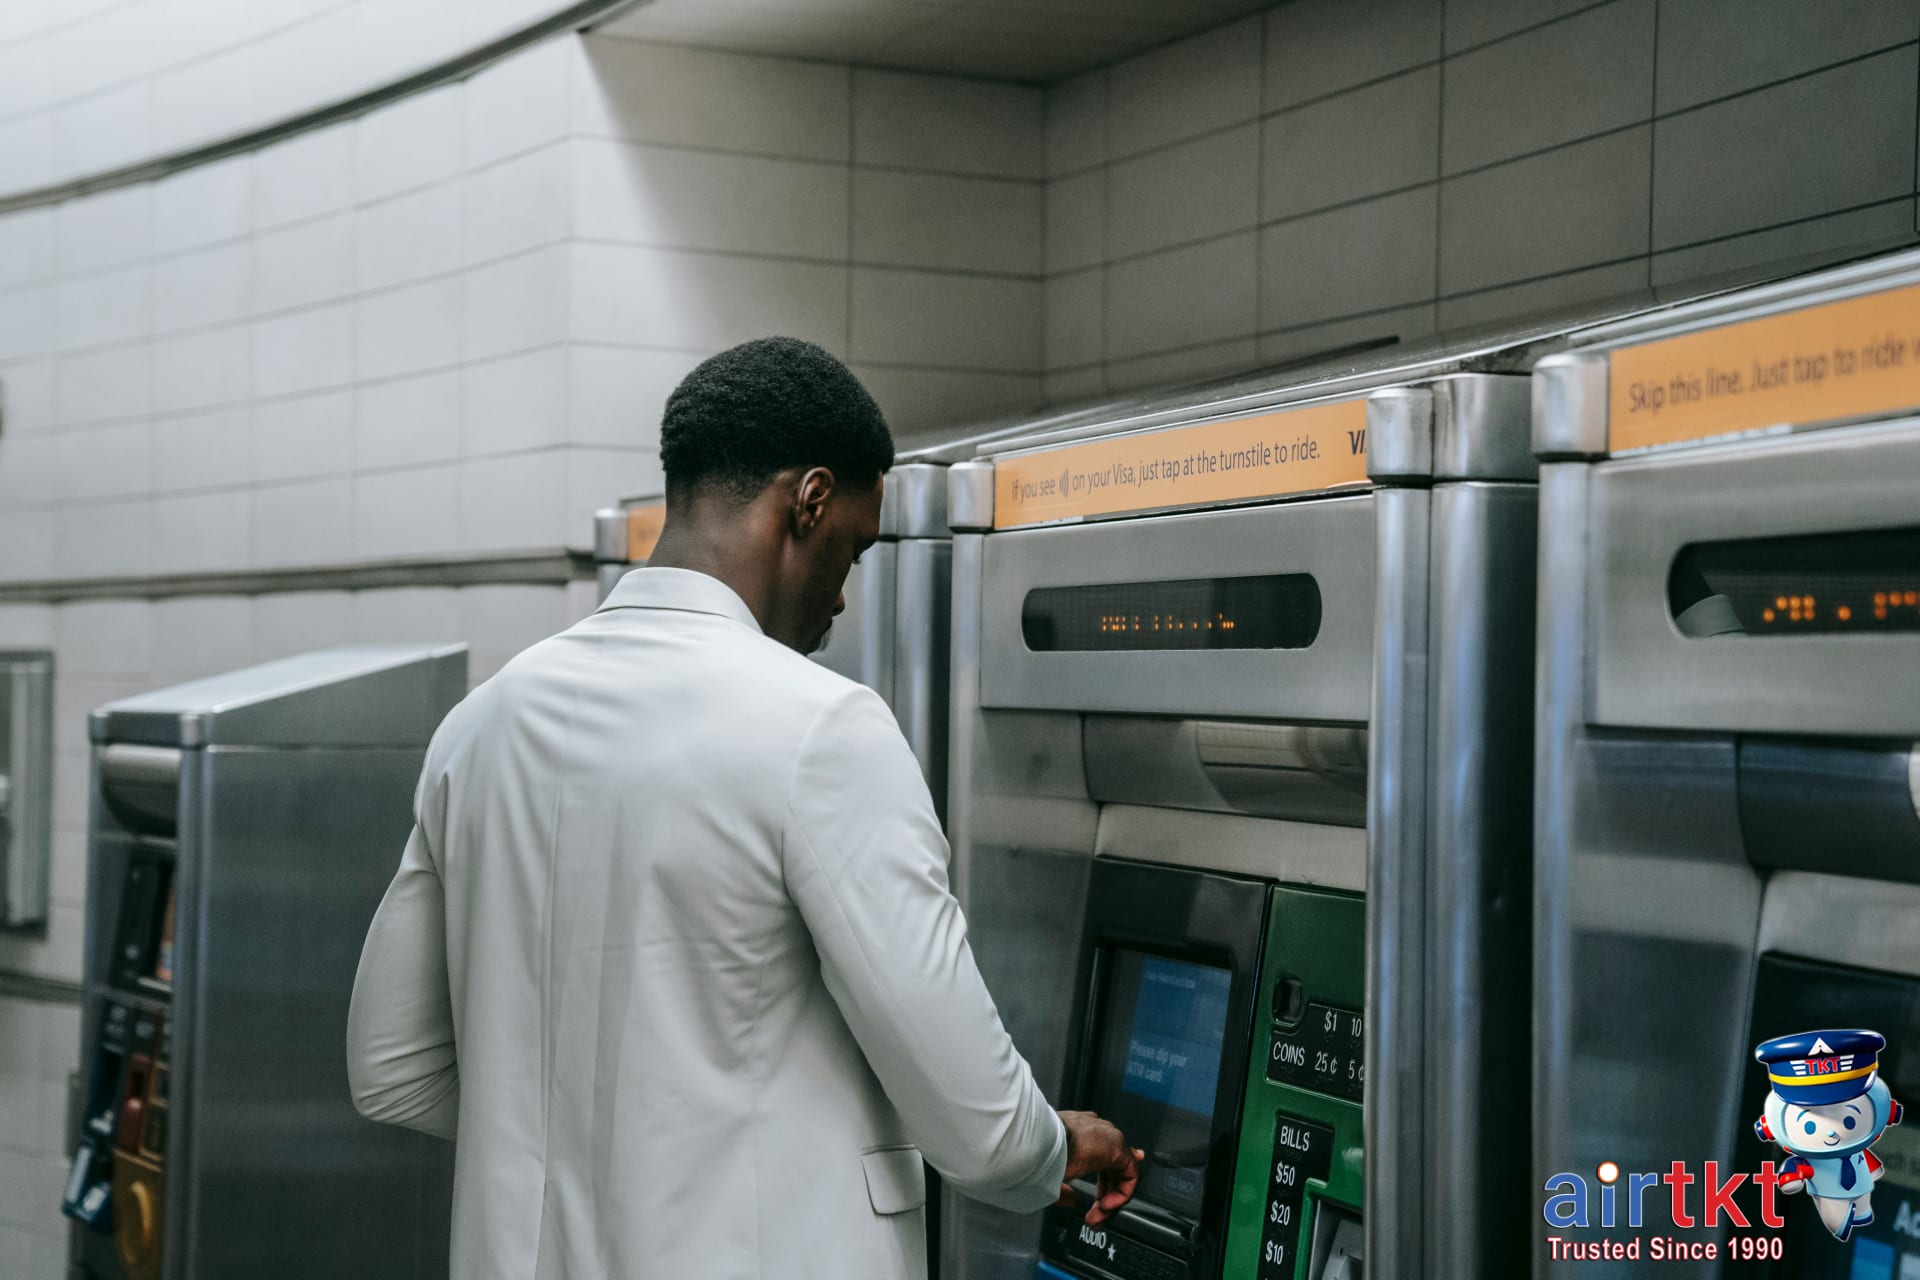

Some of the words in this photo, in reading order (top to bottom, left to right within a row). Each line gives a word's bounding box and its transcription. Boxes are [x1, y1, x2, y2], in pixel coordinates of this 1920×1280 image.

[1629, 381, 1665, 415] Skip
[1669, 374, 1702, 405] this
[1705, 366, 1743, 397] line.
[1749, 358, 1790, 392] Just
[1793, 352, 1828, 387] tap
[1833, 347, 1856, 376] to
[1861, 334, 1906, 370] ride
[1020, 481, 1038, 504] you
[1039, 478, 1056, 496] see
[1072, 473, 1085, 491] on
[1088, 469, 1112, 494] your
[1112, 463, 1136, 486] Visa,
[1138, 458, 1160, 488] just
[1161, 456, 1181, 484] tap
[1183, 454, 1195, 476] at
[1197, 449, 1217, 474] the
[1220, 440, 1272, 472] turnstile
[1274, 441, 1288, 464] to
[1291, 433, 1321, 462] ride.
[1324, 1008, 1338, 1032] $1
[1272, 1041, 1306, 1067] COINS
[1280, 1125, 1311, 1152] BILLS
[1275, 1161, 1296, 1187] $50
[1270, 1200, 1291, 1226] $20
[1079, 1224, 1107, 1250] AUDIO
[1265, 1239, 1284, 1265] $10
